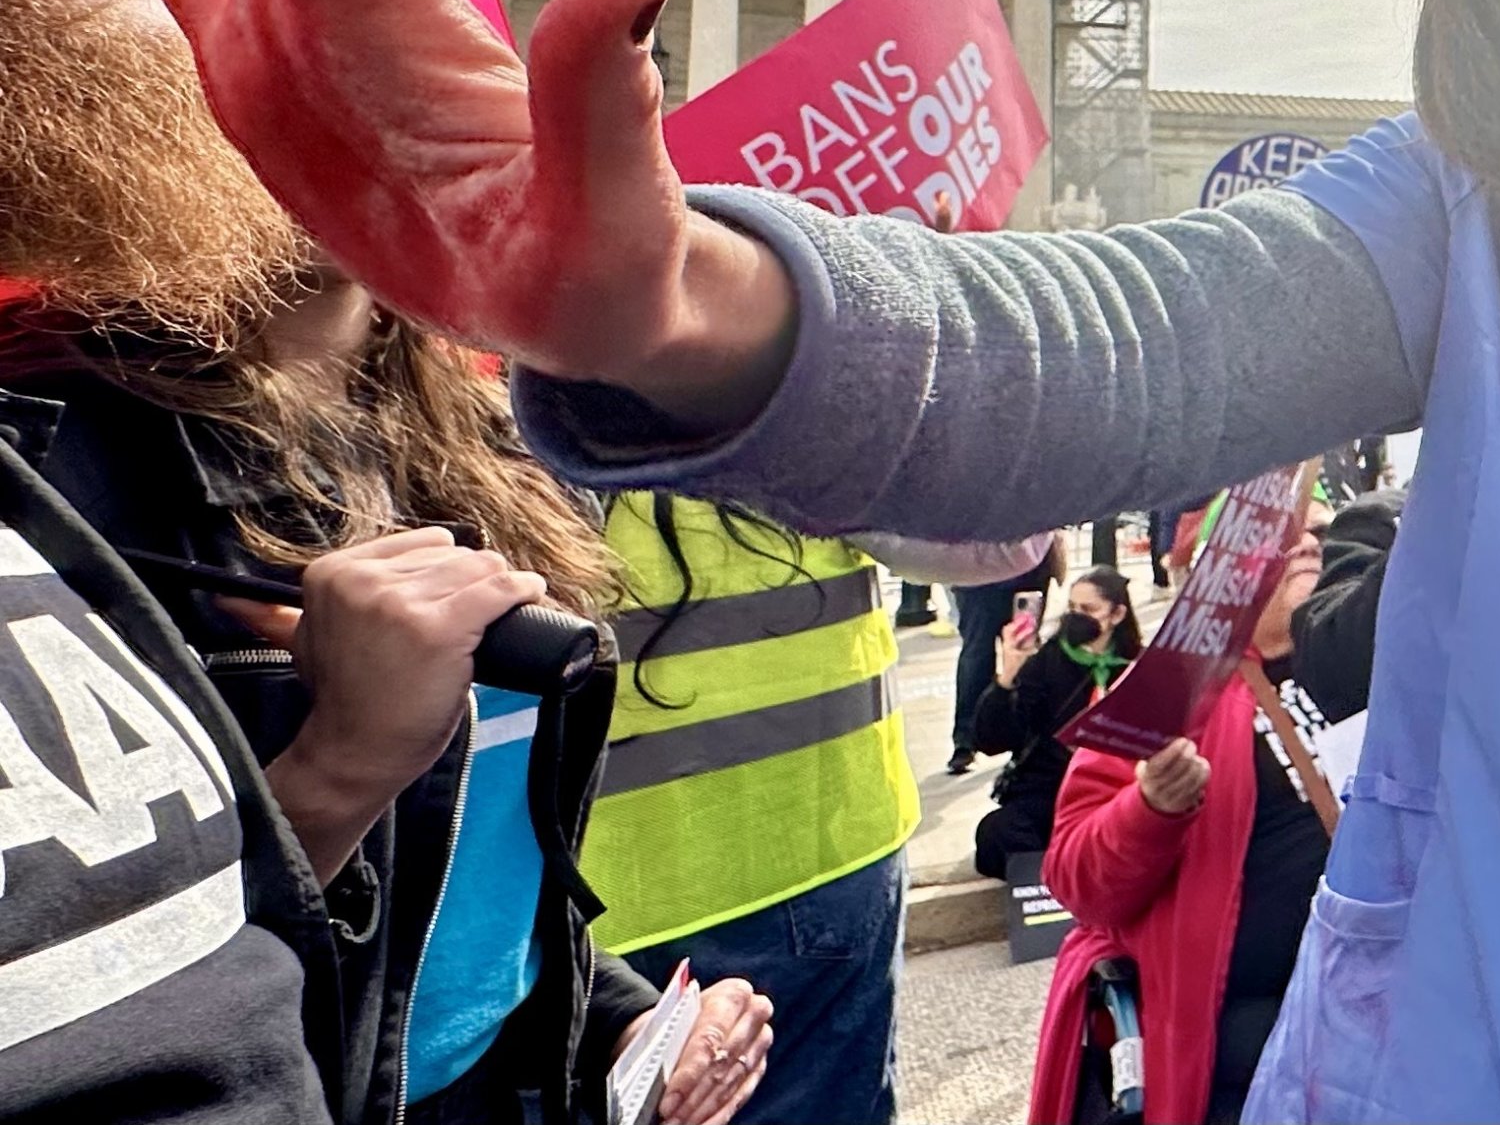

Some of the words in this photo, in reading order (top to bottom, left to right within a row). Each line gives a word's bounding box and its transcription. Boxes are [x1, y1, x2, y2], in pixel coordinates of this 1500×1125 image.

[740, 40, 918, 192] BANS
[909, 41, 992, 156] OUR
[1239, 137, 1328, 178] KEE
[887, 106, 1001, 228] DIES
